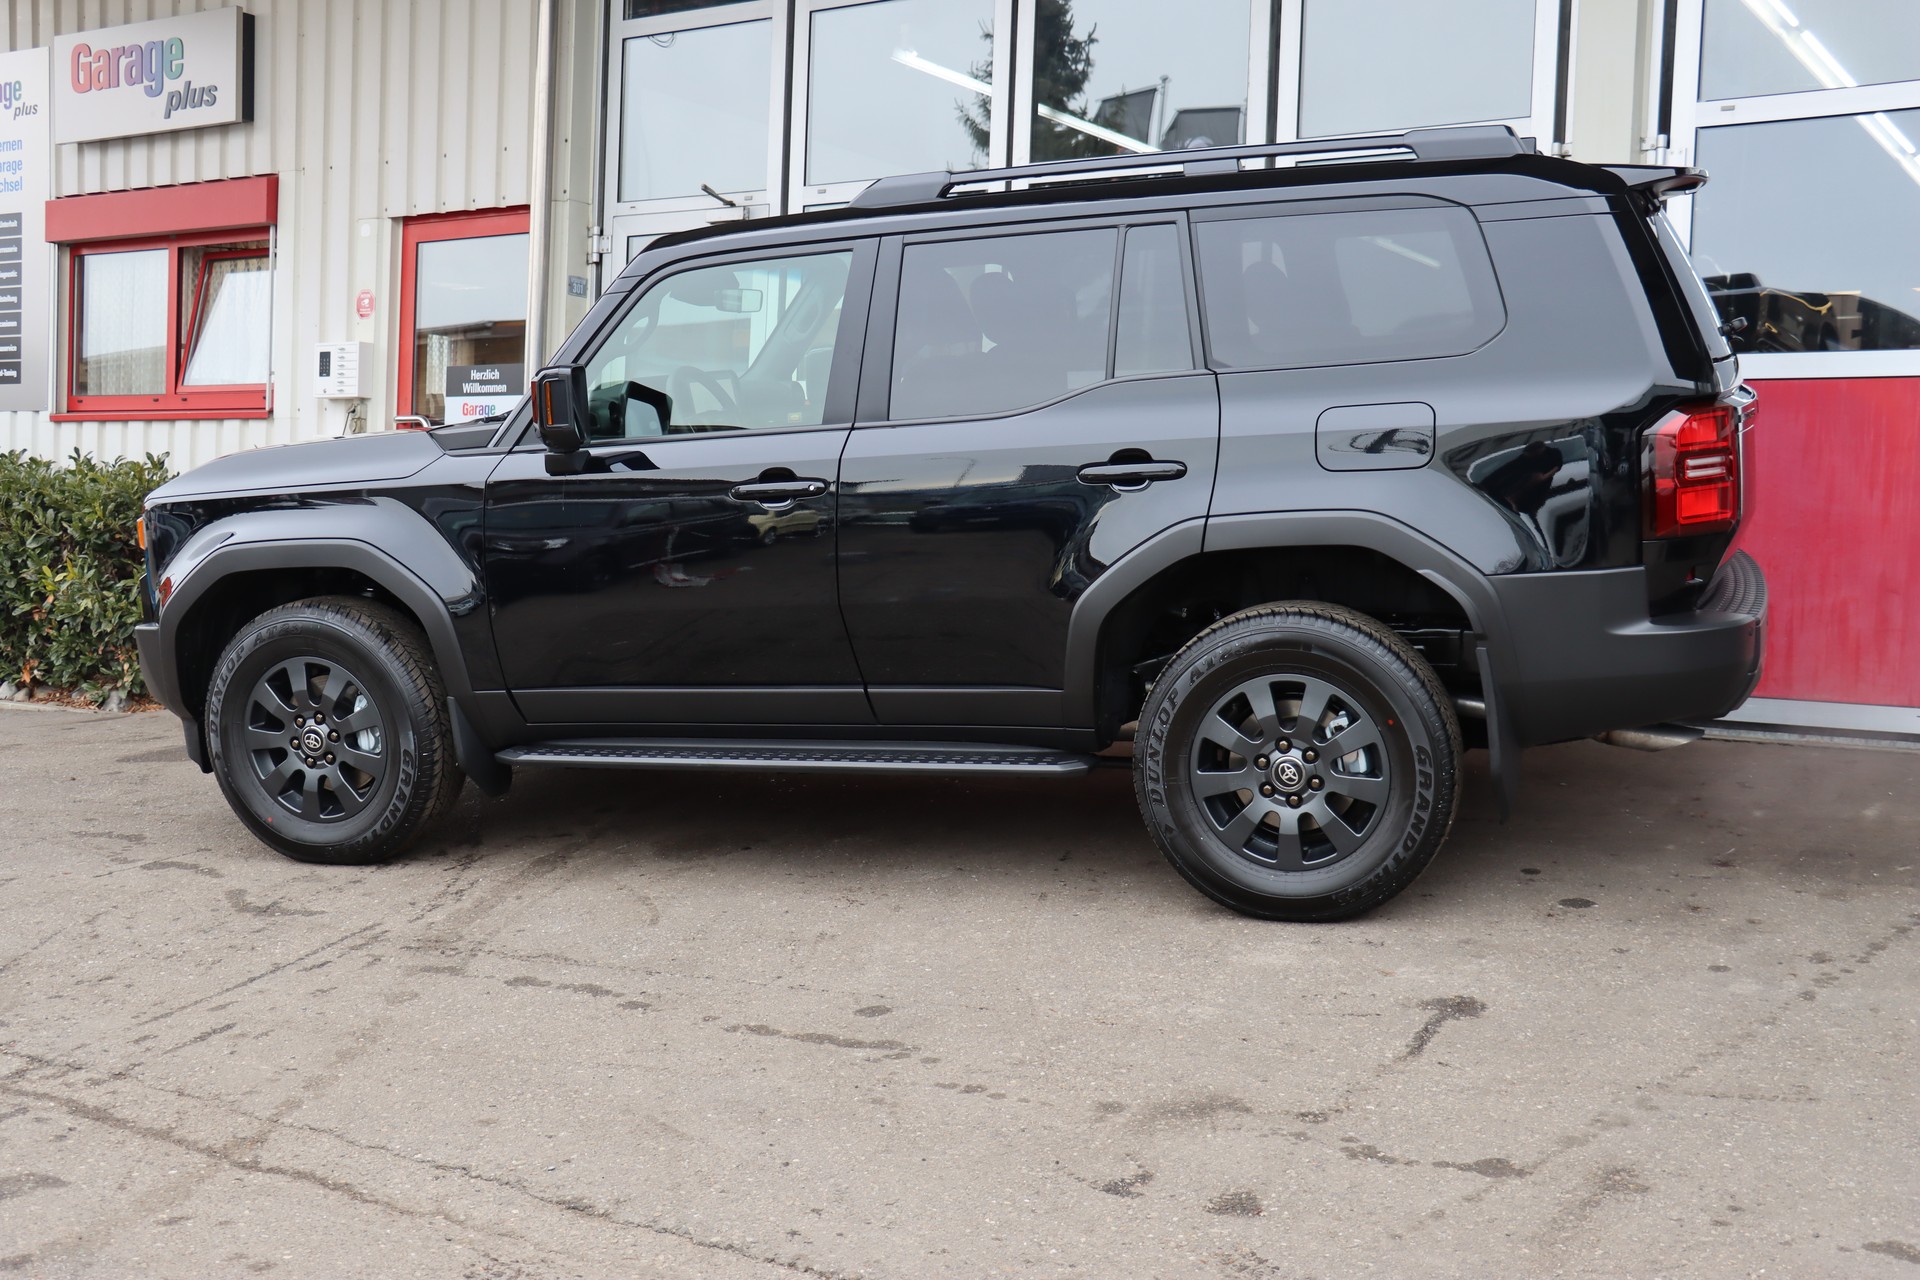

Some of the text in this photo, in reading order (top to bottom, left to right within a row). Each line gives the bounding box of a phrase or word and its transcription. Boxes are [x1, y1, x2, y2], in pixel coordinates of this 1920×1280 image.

[71, 36, 184, 98] Garage
[0, 80, 22, 110] ge
[164, 80, 219, 120] plus
[13, 102, 38, 120] plus
[572, 282, 583, 294] 301
[470, 369, 500, 380] Herzlich
[462, 382, 507, 394] Willkommen
[462, 402, 496, 417] Garage
[210, 645, 245, 738] DUNLOP
[1147, 687, 1180, 809] DUNLOP
